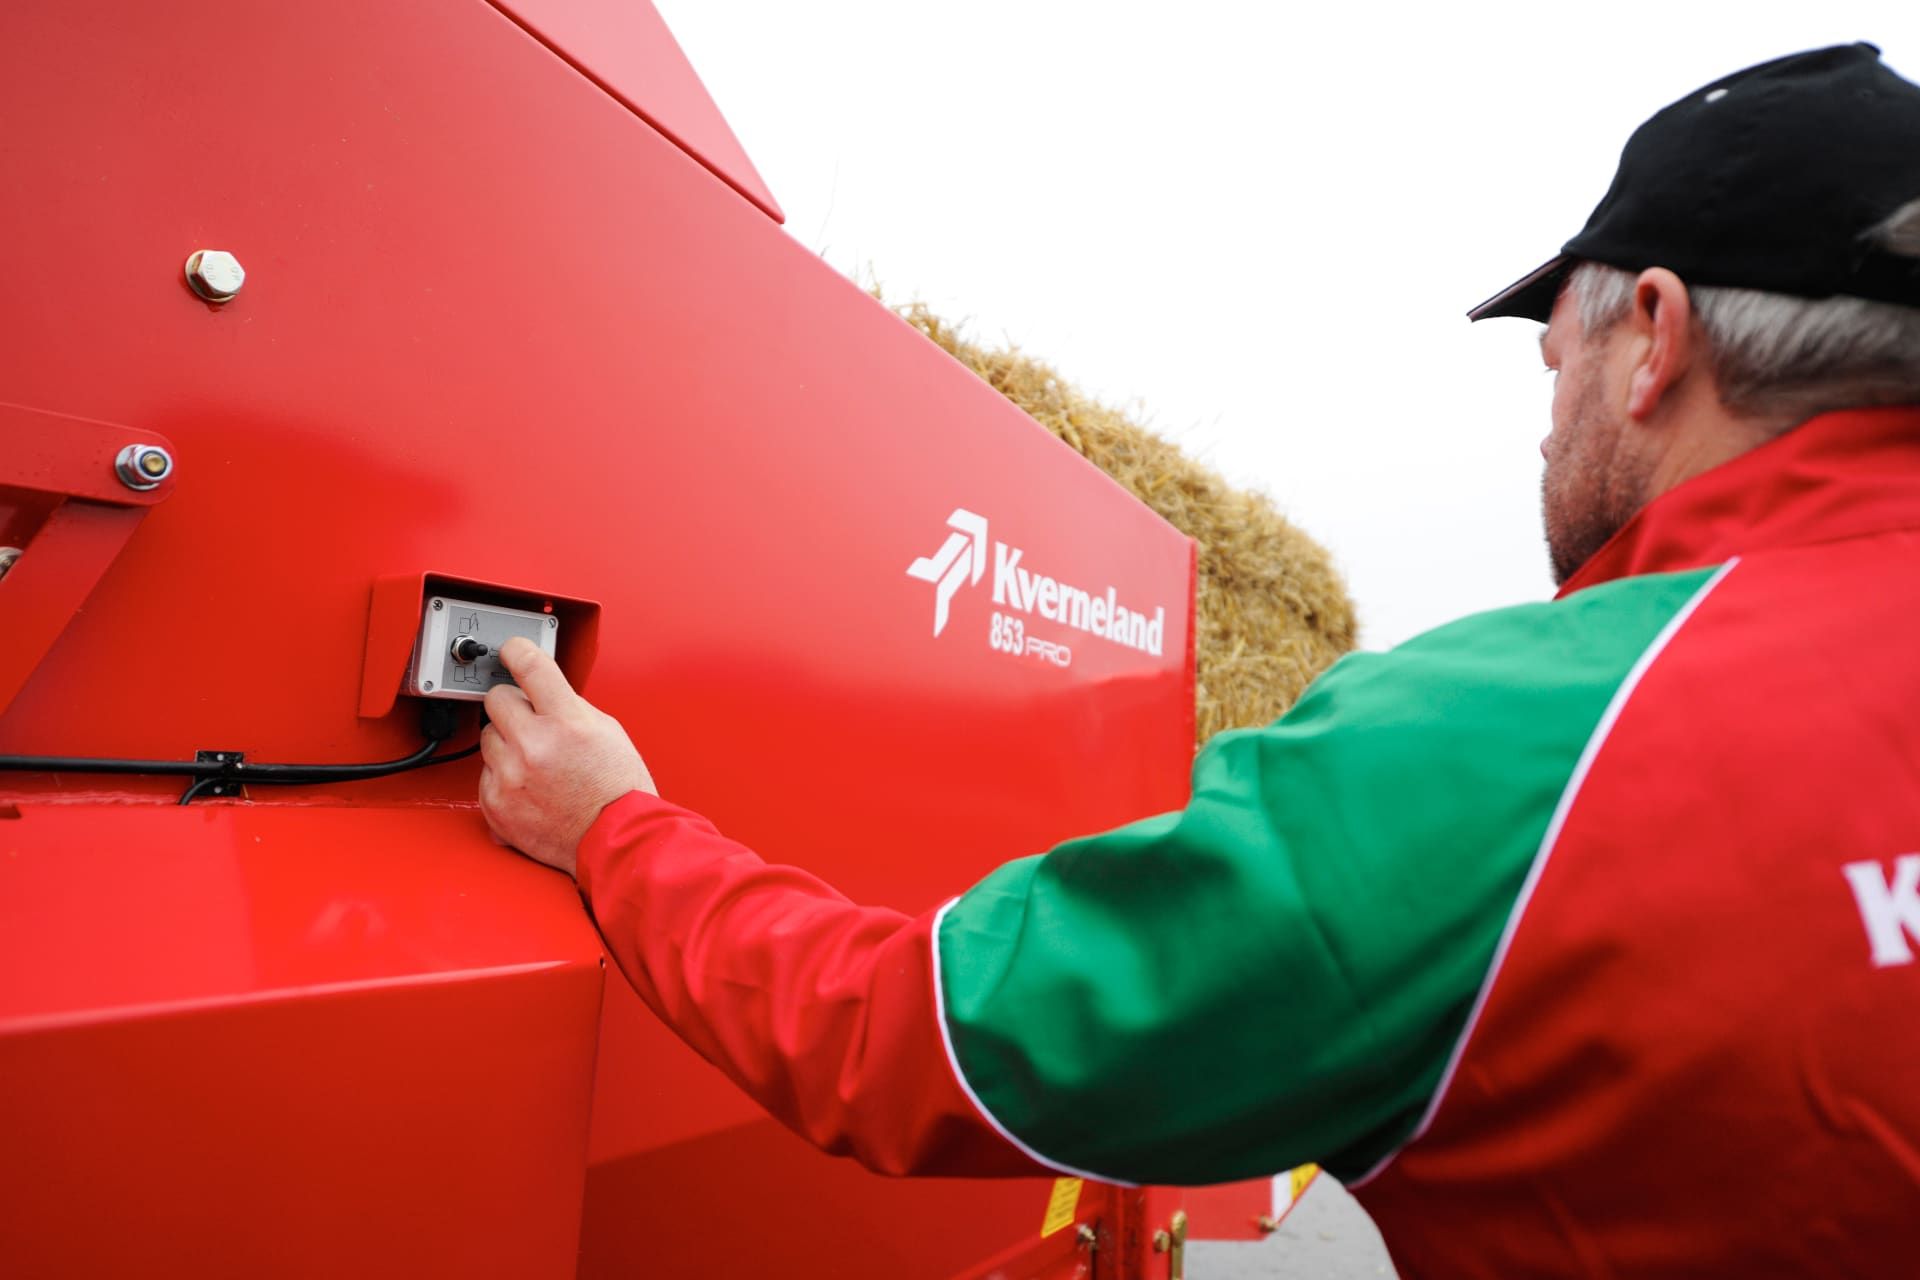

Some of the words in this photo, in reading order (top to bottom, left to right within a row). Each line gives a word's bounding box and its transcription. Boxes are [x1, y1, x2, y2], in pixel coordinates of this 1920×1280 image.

[991, 613, 1024, 655] 853
[1025, 637, 1071, 666] PRO
[993, 542, 1164, 655] Kverneland
